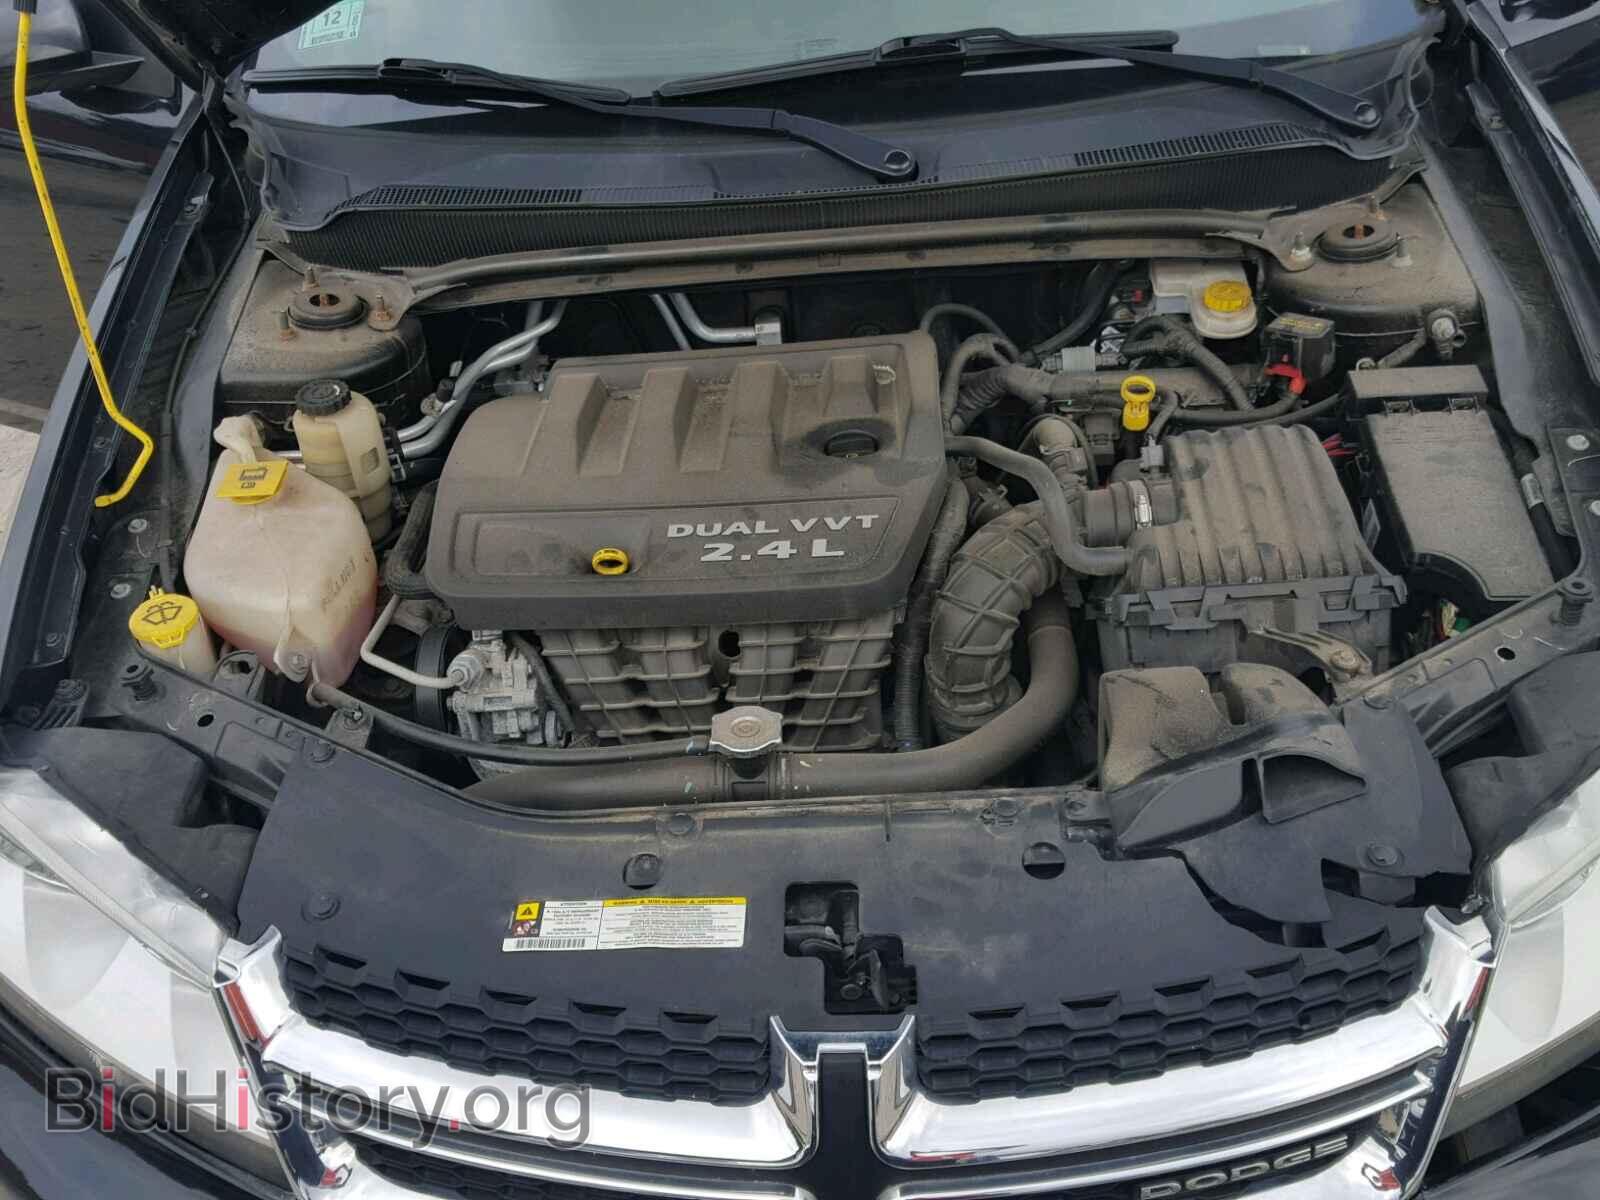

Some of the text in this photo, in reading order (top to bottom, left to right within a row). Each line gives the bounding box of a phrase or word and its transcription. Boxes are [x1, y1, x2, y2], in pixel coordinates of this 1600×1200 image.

[322, 10, 342, 27] 12
[667, 514, 880, 538] DUAL VVT
[700, 538, 845, 563] 2.4 L
[1139, 1135, 1349, 1200] DODGE
